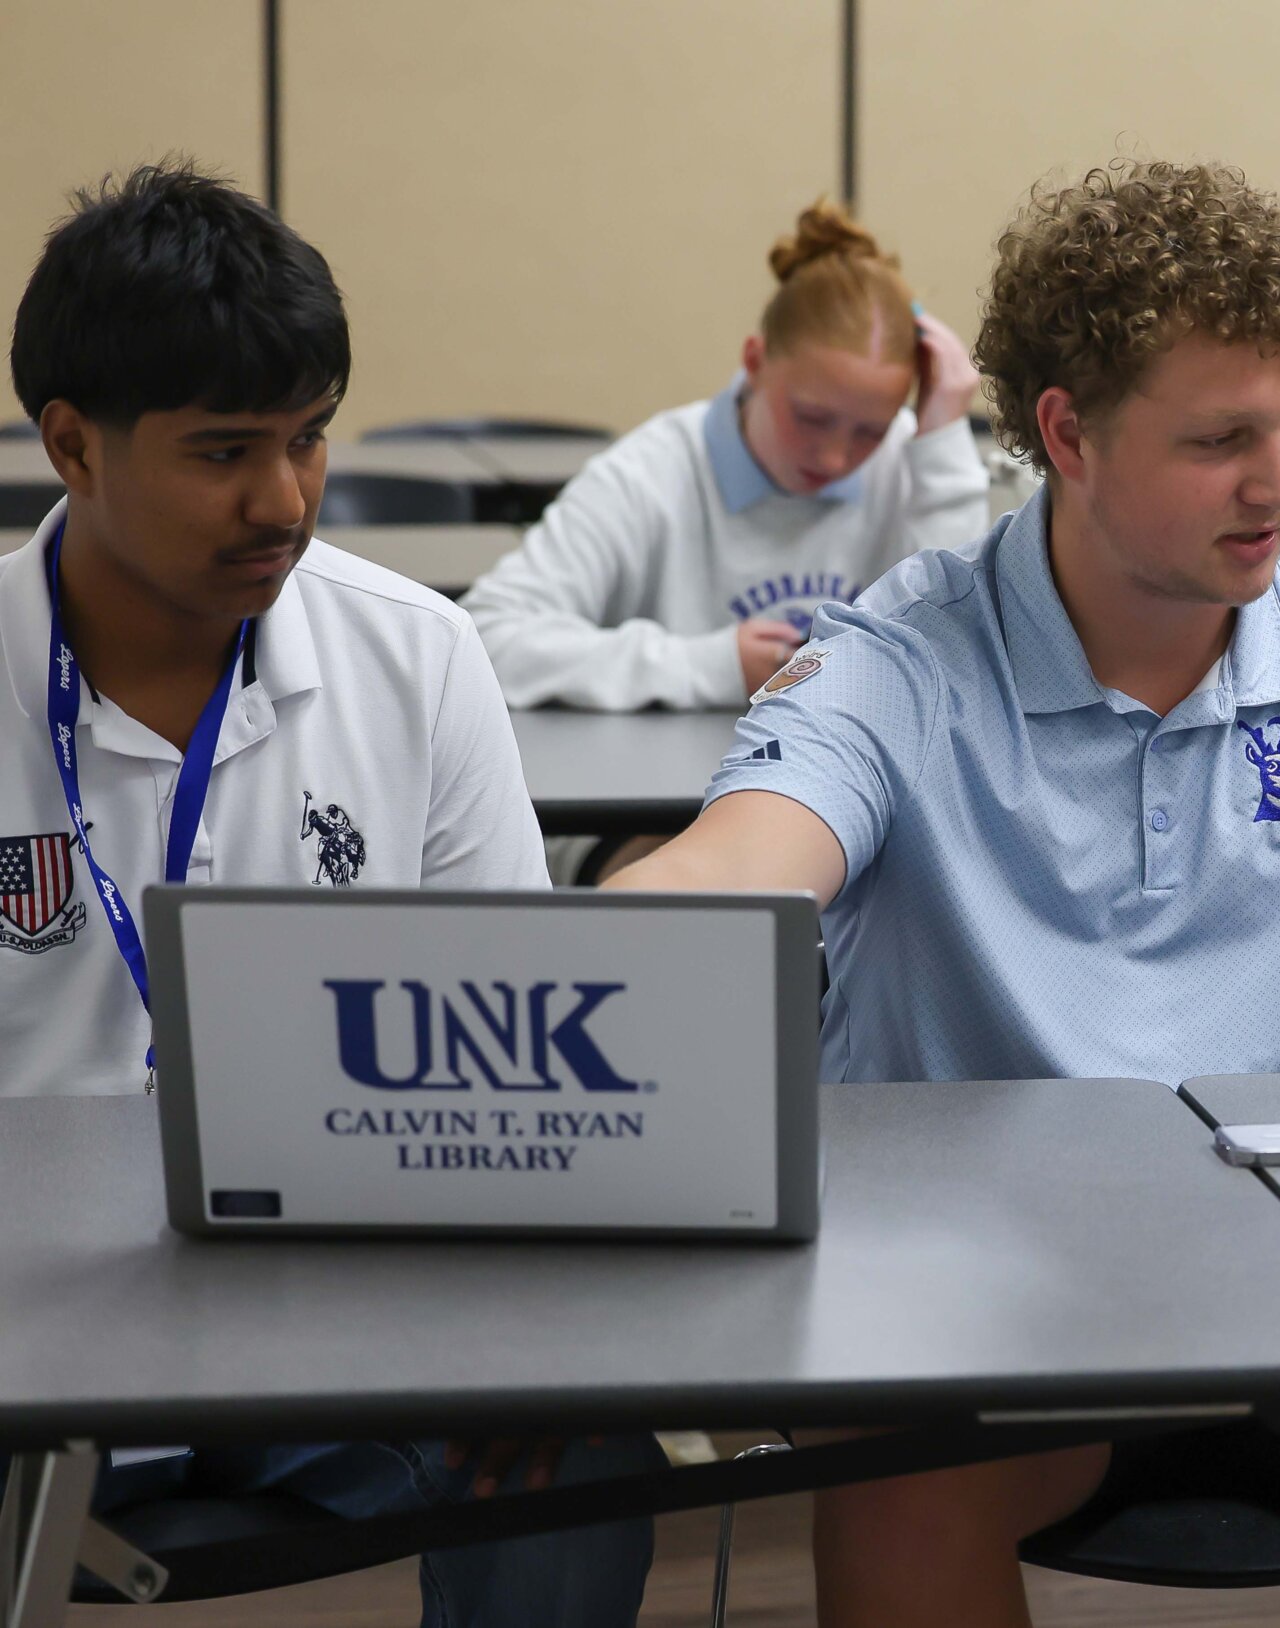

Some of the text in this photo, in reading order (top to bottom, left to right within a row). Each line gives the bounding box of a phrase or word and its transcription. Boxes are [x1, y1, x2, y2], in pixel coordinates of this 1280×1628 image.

[60, 643, 75, 691] Lopers
[57, 722, 72, 769] Lopers
[100, 878, 123, 923] Lopers
[323, 979, 639, 1092] UNK
[325, 1108, 644, 1138] CALVIN T. RYAN
[397, 1144, 578, 1172] LIBRARY
